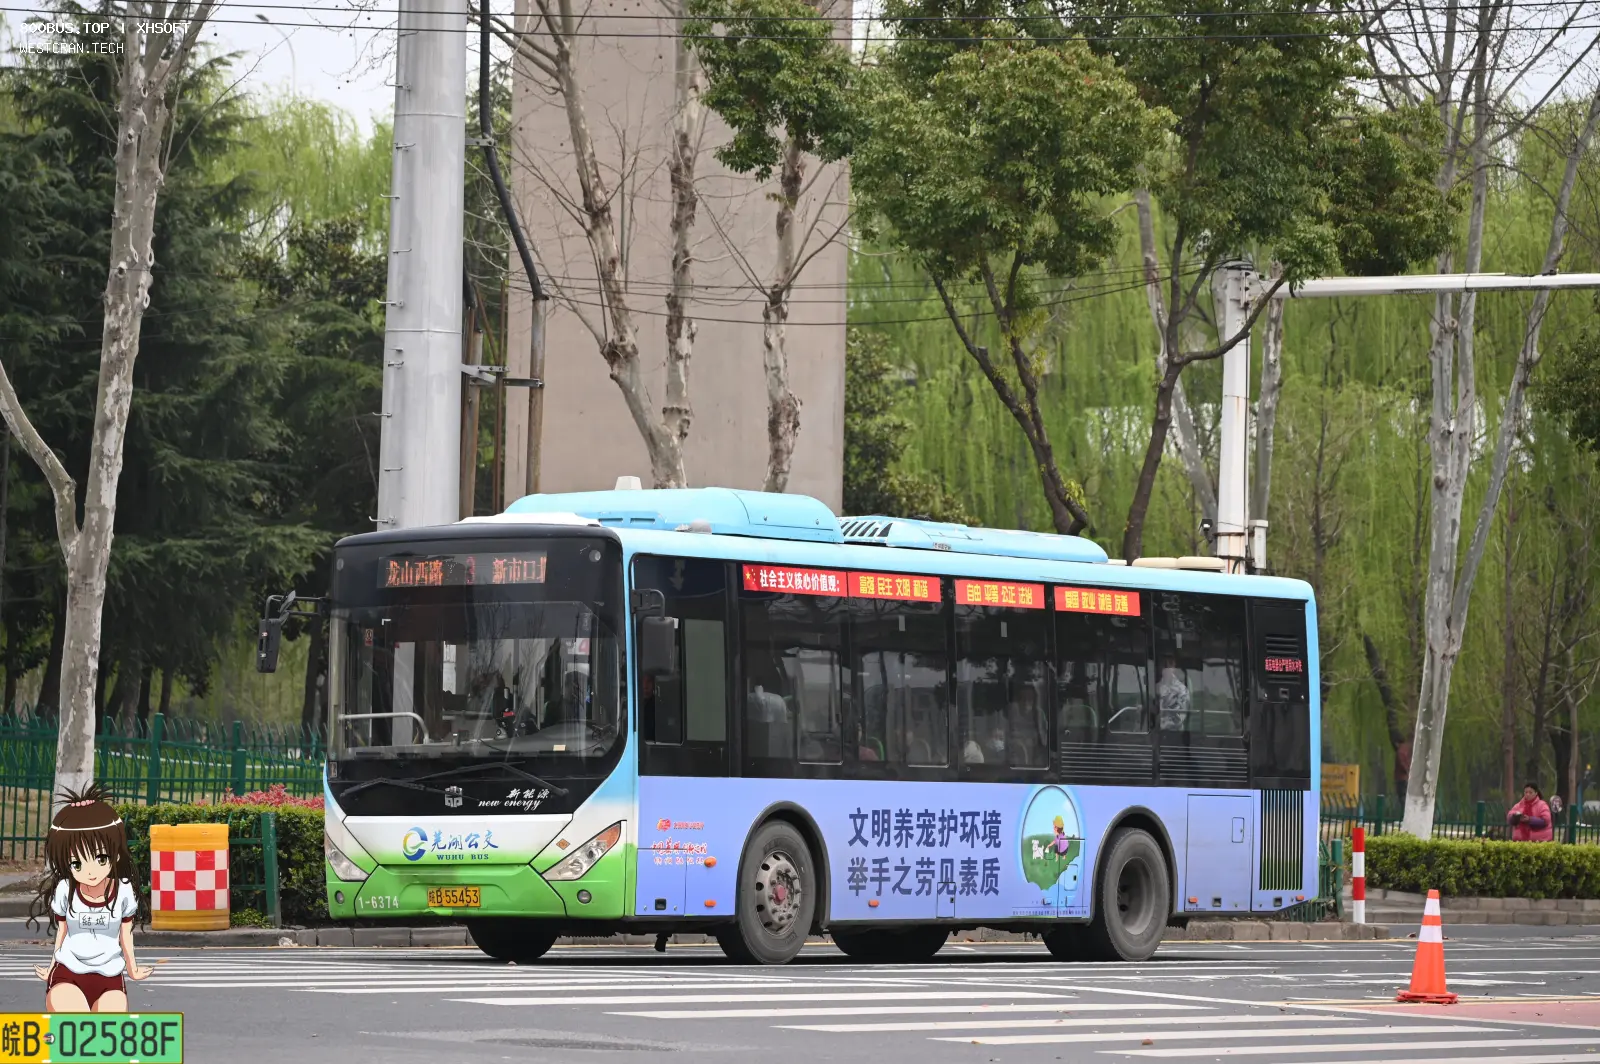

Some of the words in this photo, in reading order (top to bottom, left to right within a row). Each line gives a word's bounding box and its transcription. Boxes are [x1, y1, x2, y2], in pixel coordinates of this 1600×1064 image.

[859, 575, 875, 595] 富强
[877, 576, 893, 596] 民主
[895, 578, 911, 597] 文明
[913, 579, 929, 598] 和谐
[966, 583, 982, 602] 自由
[984, 584, 998, 603] 平等
[1001, 585, 1016, 604] 公正
[1018, 587, 1033, 605] 法治
[1065, 590, 1079, 609] 爱国
[1081, 591, 1095, 610] 敬业
[1098, 592, 1112, 612] 诚信
[1114, 594, 1129, 613] 友善
[478, 799, 501, 807] new
[504, 799, 543, 811] energy
[506, 788, 550, 800] 新能源
[848, 807, 1002, 848] 文明养宠护环境
[431, 829, 499, 852] 芜湖公交
[847, 856, 1001, 897] 举手之劳见素质
[358, 895, 399, 909] 1-6374
